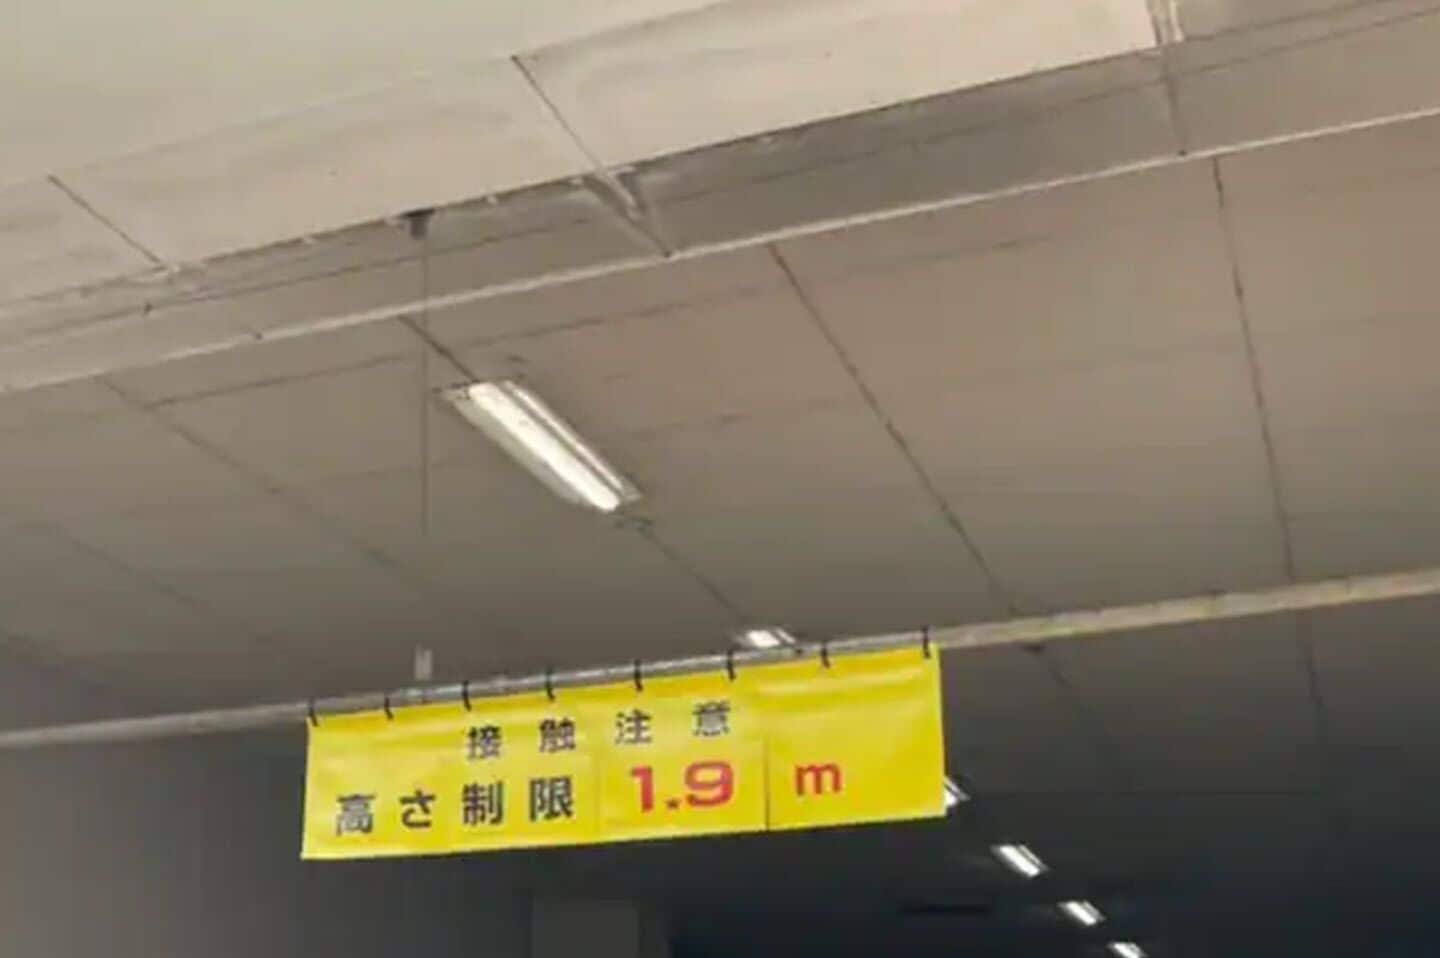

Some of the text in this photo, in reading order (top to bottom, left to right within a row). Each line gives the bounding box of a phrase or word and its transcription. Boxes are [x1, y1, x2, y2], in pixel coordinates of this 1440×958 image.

[465, 700, 731, 760] 接触注意
[335, 760, 843, 836] 高さ制限 1.9 m
